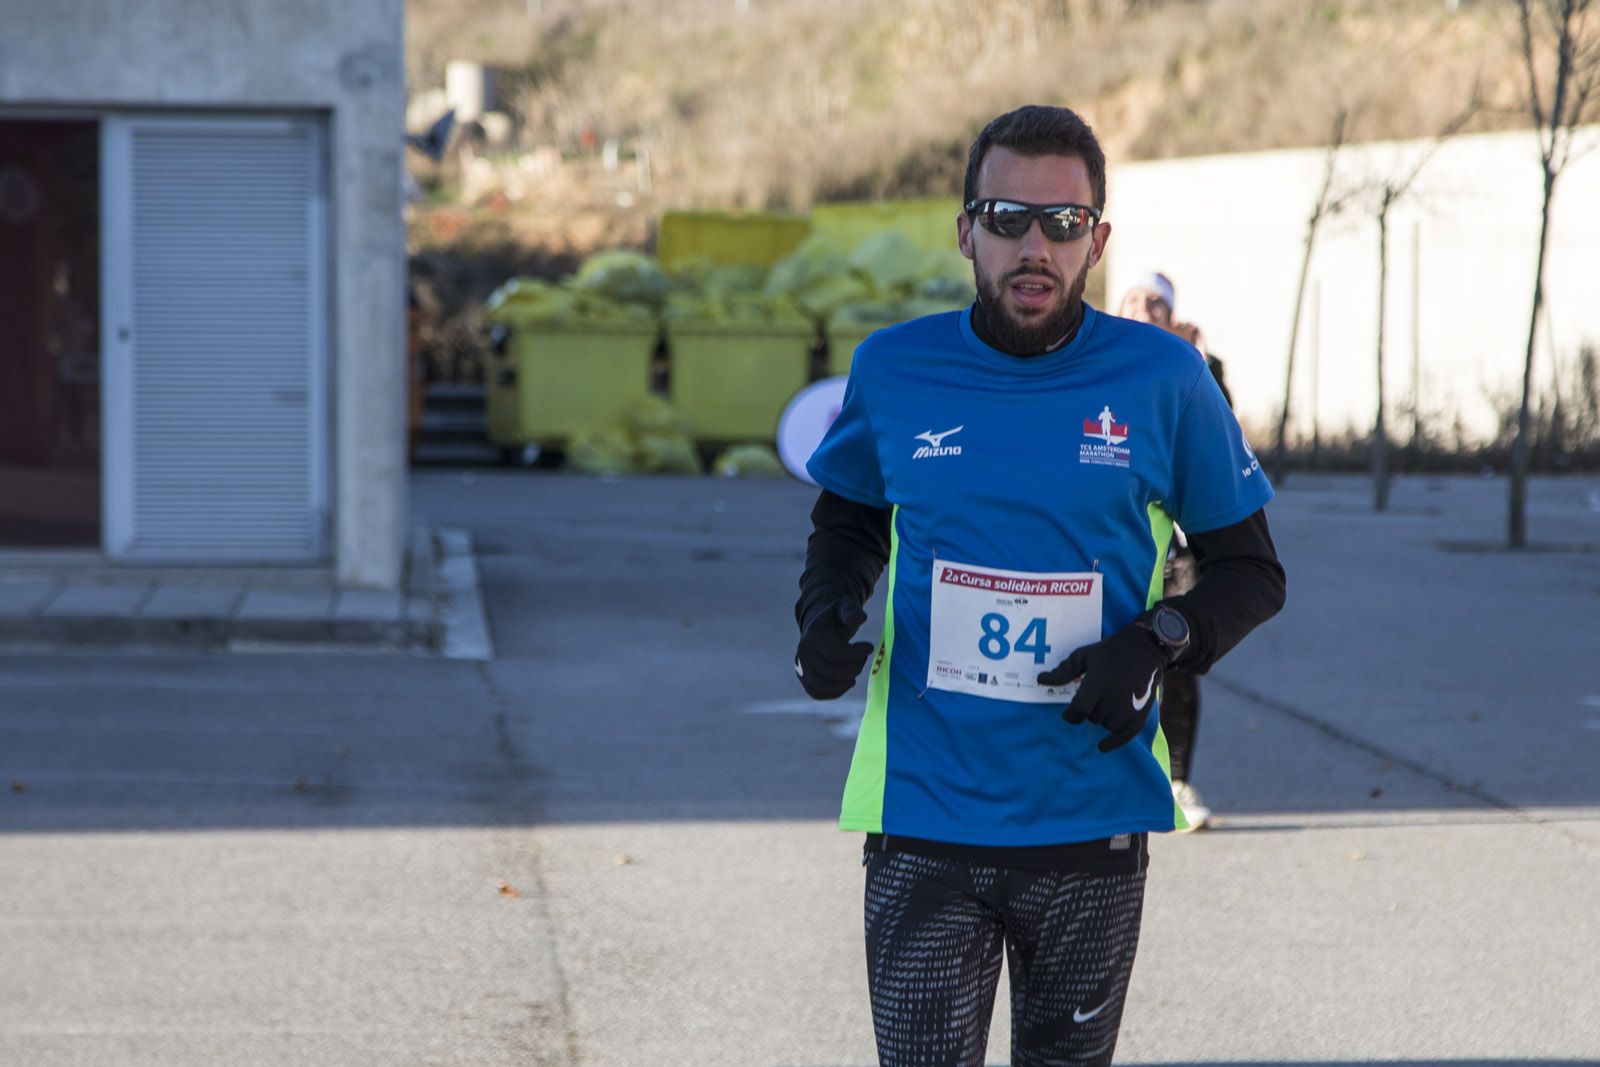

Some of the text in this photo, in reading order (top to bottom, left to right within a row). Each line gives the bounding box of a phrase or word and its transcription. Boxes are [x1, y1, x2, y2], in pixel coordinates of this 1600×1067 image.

[1080, 450, 1115, 458] MARATHON
[994, 578, 1048, 594] solidària
[1050, 581, 1089, 594] RICOH
[978, 612, 1051, 665] 84
